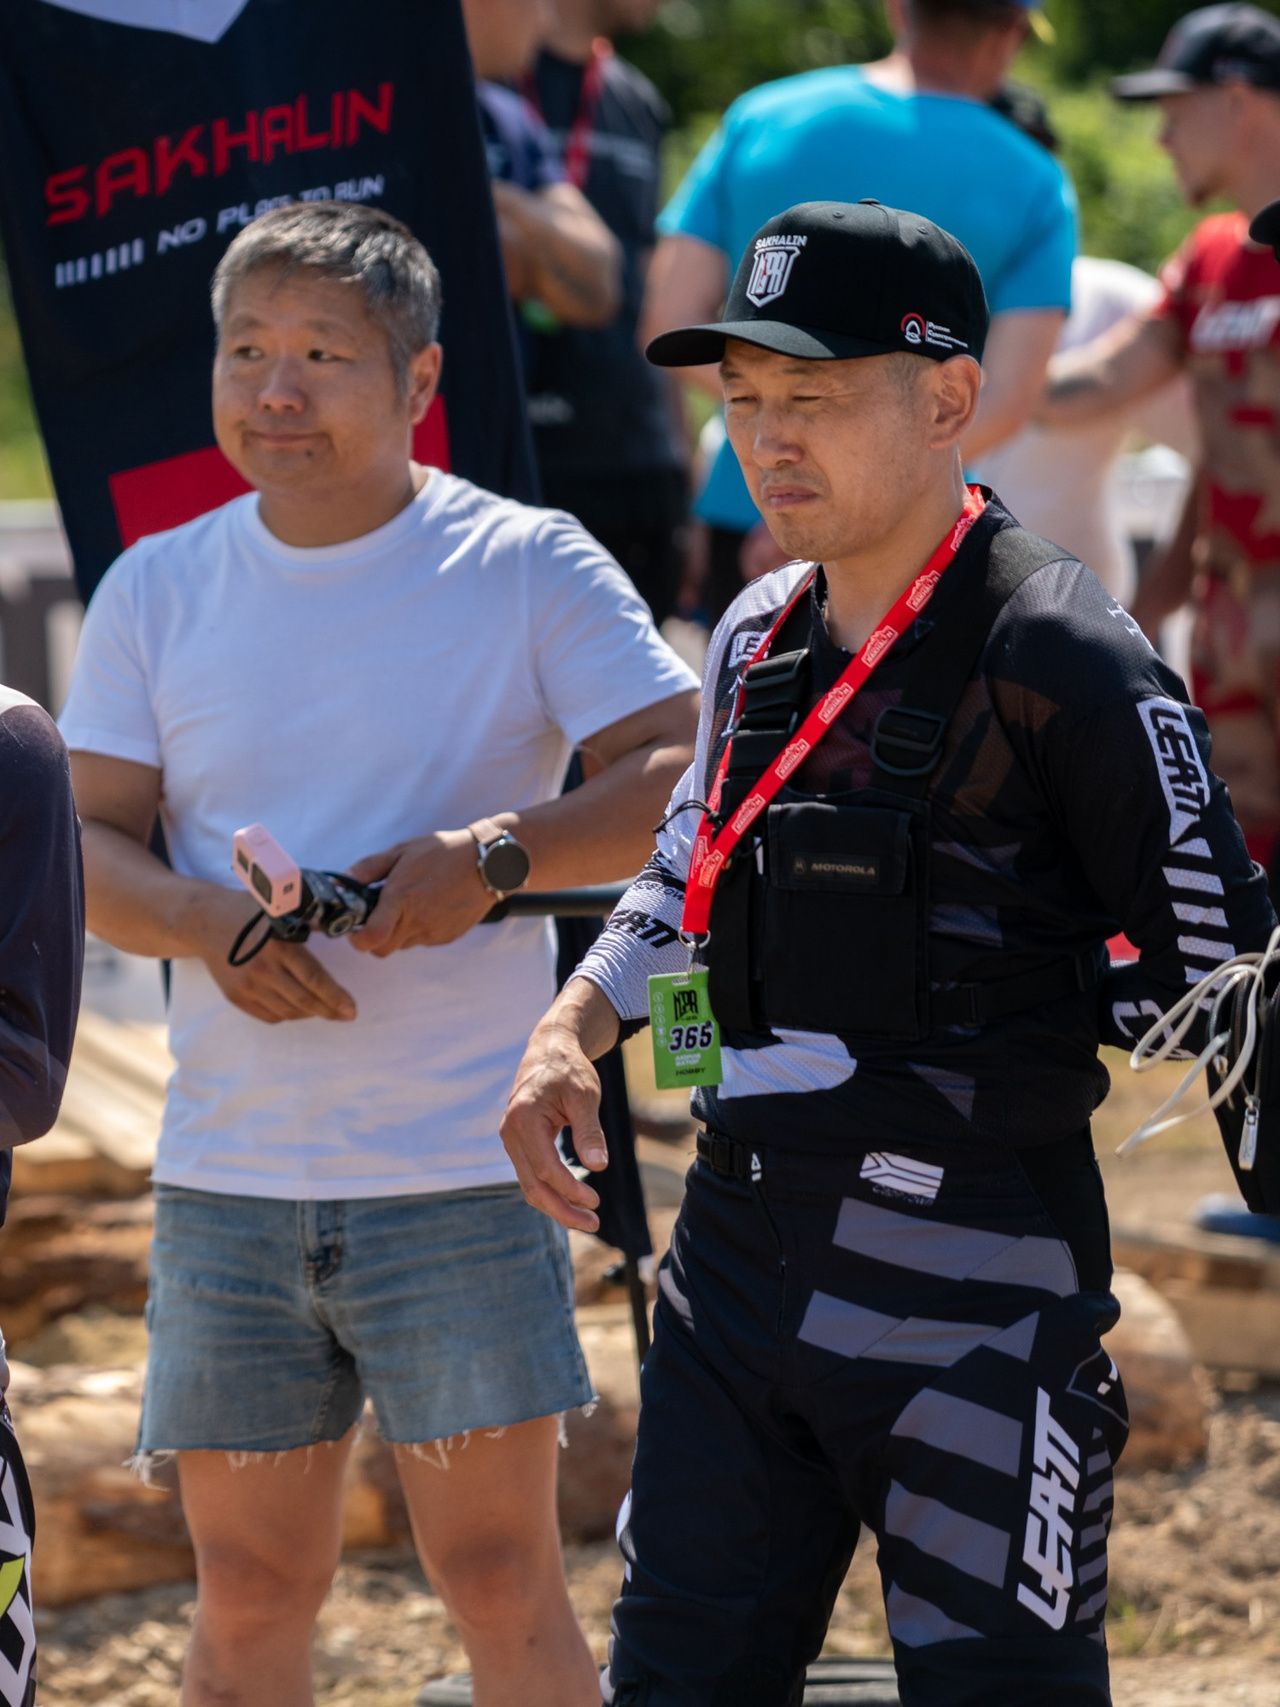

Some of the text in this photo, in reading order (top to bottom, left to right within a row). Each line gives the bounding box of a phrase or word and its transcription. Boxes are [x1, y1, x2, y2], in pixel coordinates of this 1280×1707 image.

[45, 82, 394, 226] SAKHALIN
[157, 217, 207, 254] NO
[335, 174, 385, 200] RUN
[754, 234, 808, 249] SAKHALIN
[811, 863, 876, 876] MOTOROLA
[669, 1021, 715, 1053] 365
[1017, 1386, 1080, 1631] LEATT
